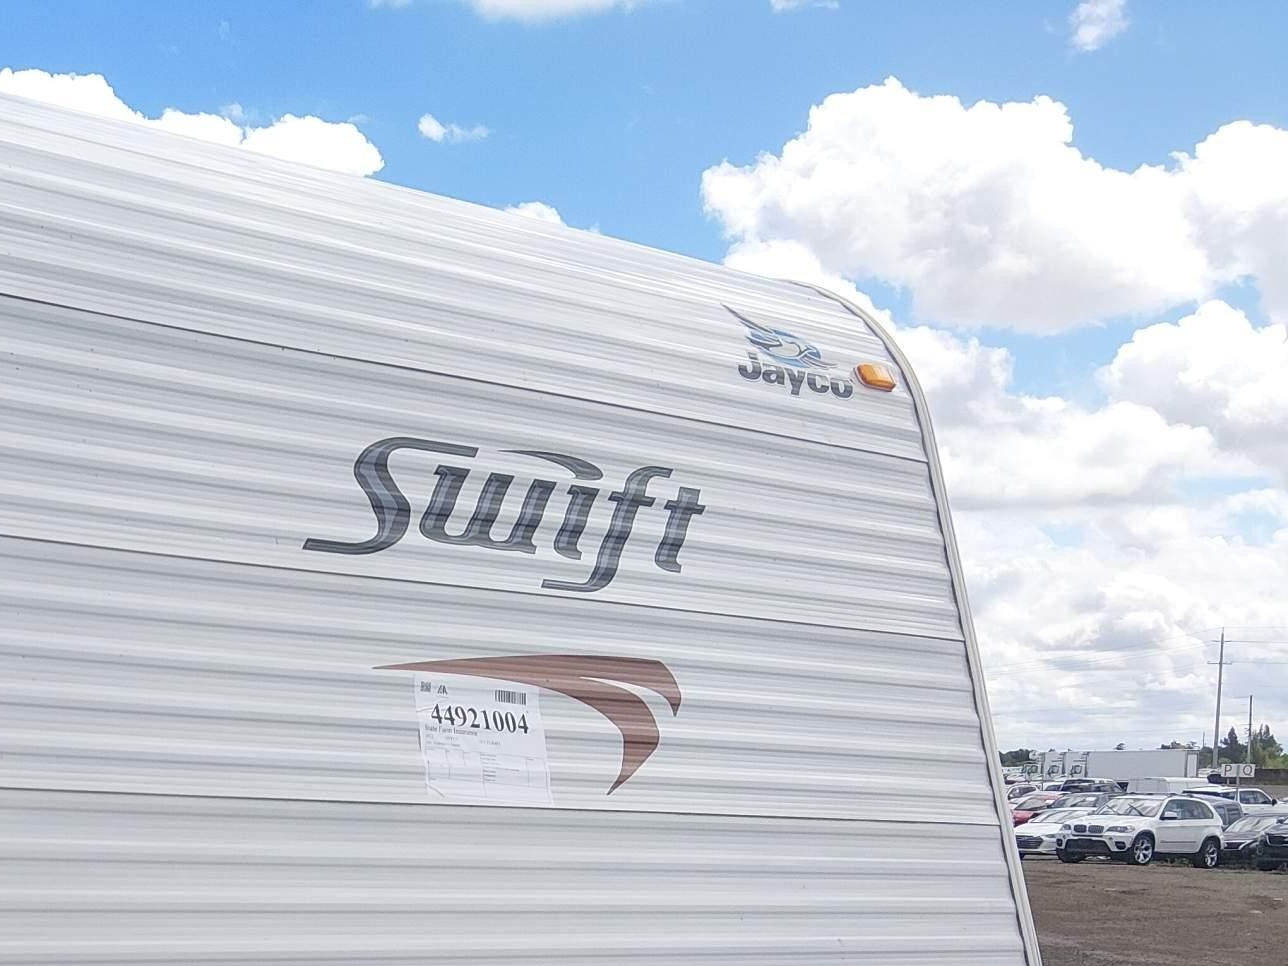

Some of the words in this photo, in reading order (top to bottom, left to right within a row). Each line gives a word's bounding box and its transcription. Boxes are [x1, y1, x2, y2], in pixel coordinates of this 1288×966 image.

[302, 436, 707, 592] Swift
[431, 703, 529, 734] 44921004
[1224, 764, 1233, 777] P
